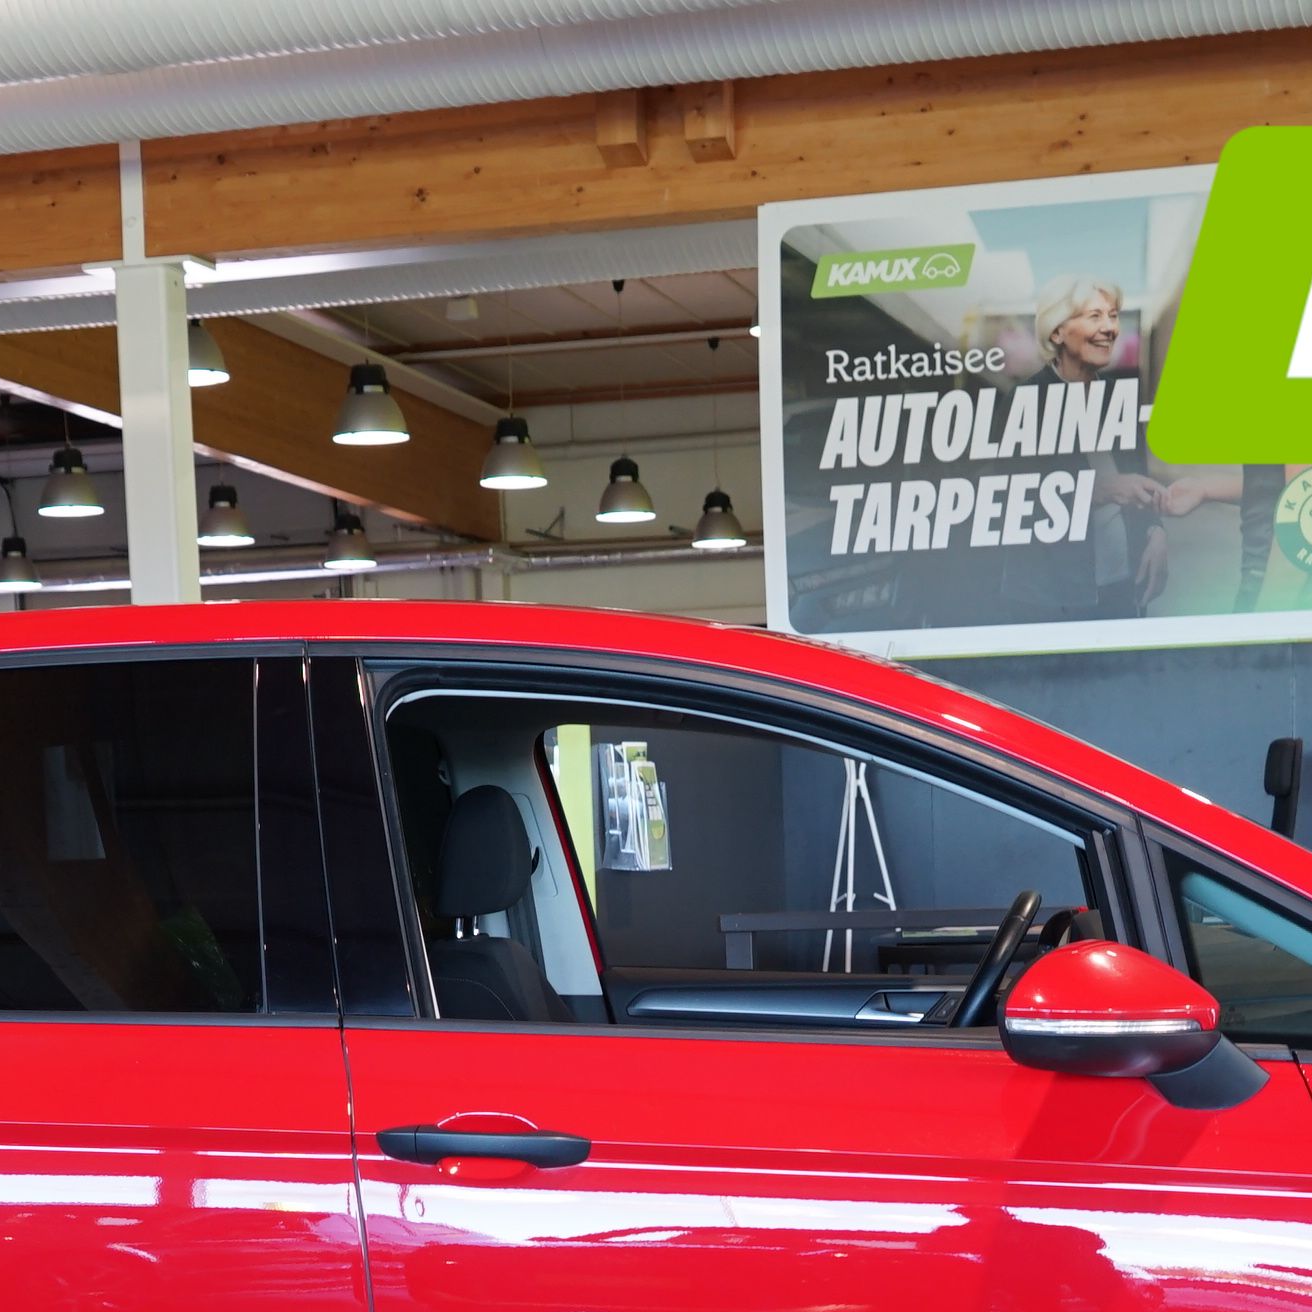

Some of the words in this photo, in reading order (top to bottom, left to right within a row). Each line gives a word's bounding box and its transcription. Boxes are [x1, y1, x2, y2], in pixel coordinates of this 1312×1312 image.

[827, 256, 921, 288] KAMUX
[825, 342, 1006, 384] Ratkaisee
[819, 377, 1155, 470] AUTOLAINA-
[829, 469, 1096, 555] TARPEESI
